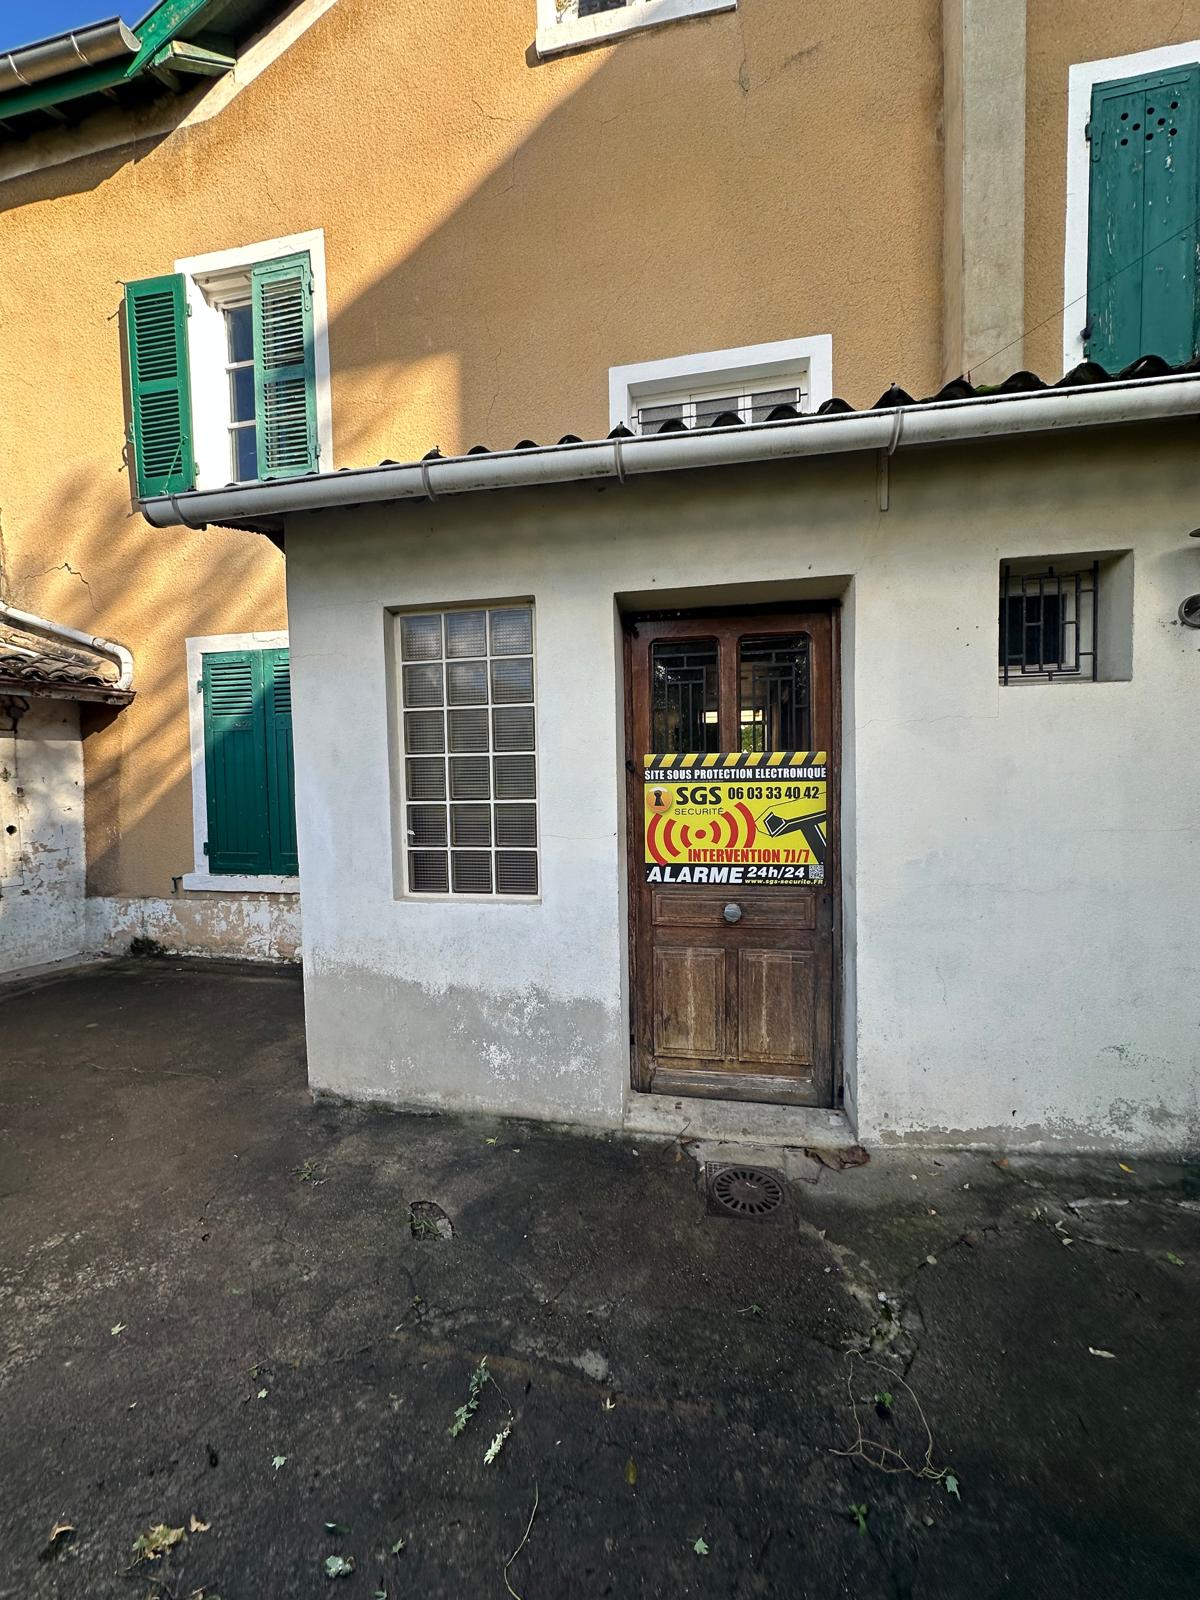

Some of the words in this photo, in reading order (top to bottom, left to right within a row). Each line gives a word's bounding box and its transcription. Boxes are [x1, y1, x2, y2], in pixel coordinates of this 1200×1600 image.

[645, 770, 664, 780] SITE
[667, 770, 691, 779] SOUS
[694, 769, 753, 779] PROTECTION
[756, 767, 826, 779] ELECTRONIQUE
[676, 787, 721, 805] SGS
[728, 787, 743, 799] 06
[747, 787, 762, 799] 03
[766, 787, 781, 799] 33
[785, 787, 800, 799] 40
[804, 787, 819, 799] 42
[688, 849, 780, 862] INTERVENTION
[784, 849, 810, 863] 7J/7
[647, 867, 744, 883] ALARME
[747, 867, 804, 878] 24h/24
